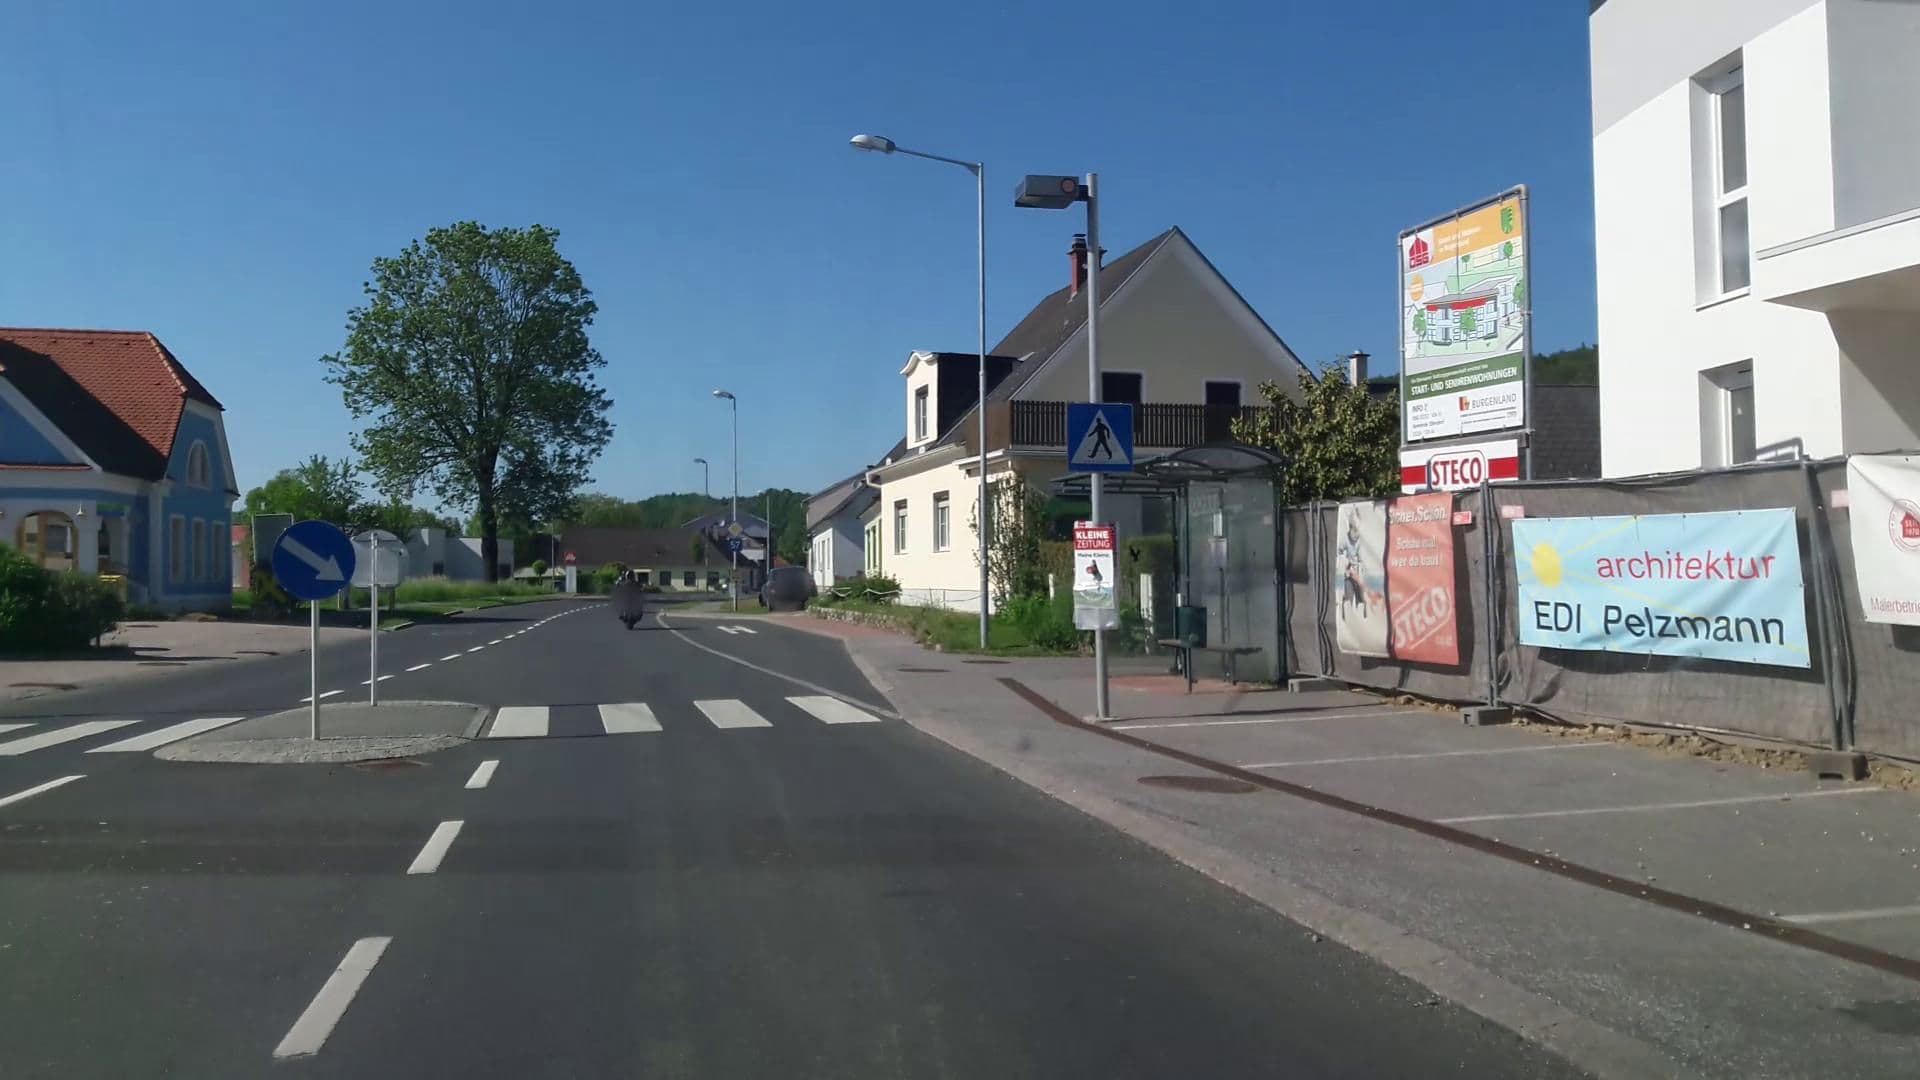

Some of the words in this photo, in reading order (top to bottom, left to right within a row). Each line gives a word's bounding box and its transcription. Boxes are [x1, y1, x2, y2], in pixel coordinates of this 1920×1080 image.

[1430, 381, 1444, 392] UND
[1472, 393, 1517, 409] BURGENLAND
[1432, 456, 1482, 486] STECO
[1075, 530, 1109, 539] KLEINE
[1076, 539, 1110, 549] ZEITUNG
[1596, 550, 1776, 581] architektur
[1394, 586, 1447, 649] STECO
[1534, 600, 1582, 633] EDI
[1604, 604, 1785, 645] Pelzmann
